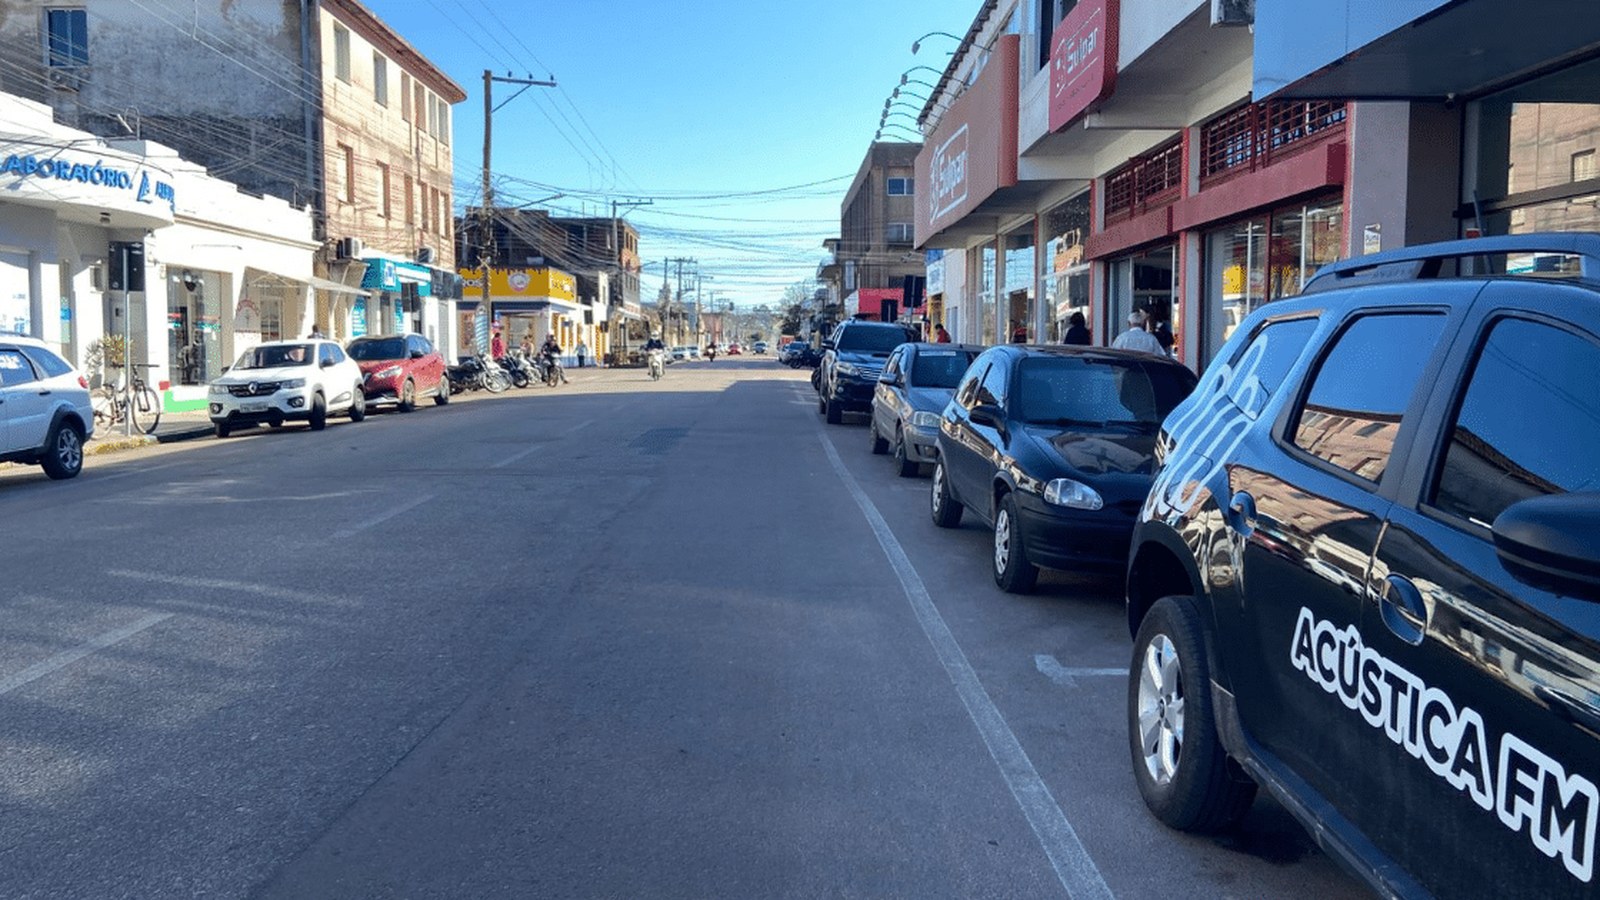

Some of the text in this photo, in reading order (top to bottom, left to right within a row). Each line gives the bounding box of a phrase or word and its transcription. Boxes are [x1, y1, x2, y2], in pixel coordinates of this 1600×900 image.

[1066, 27, 1098, 74] Sulpar
[1291, 606, 1599, 882] ACÚSTICA FM
